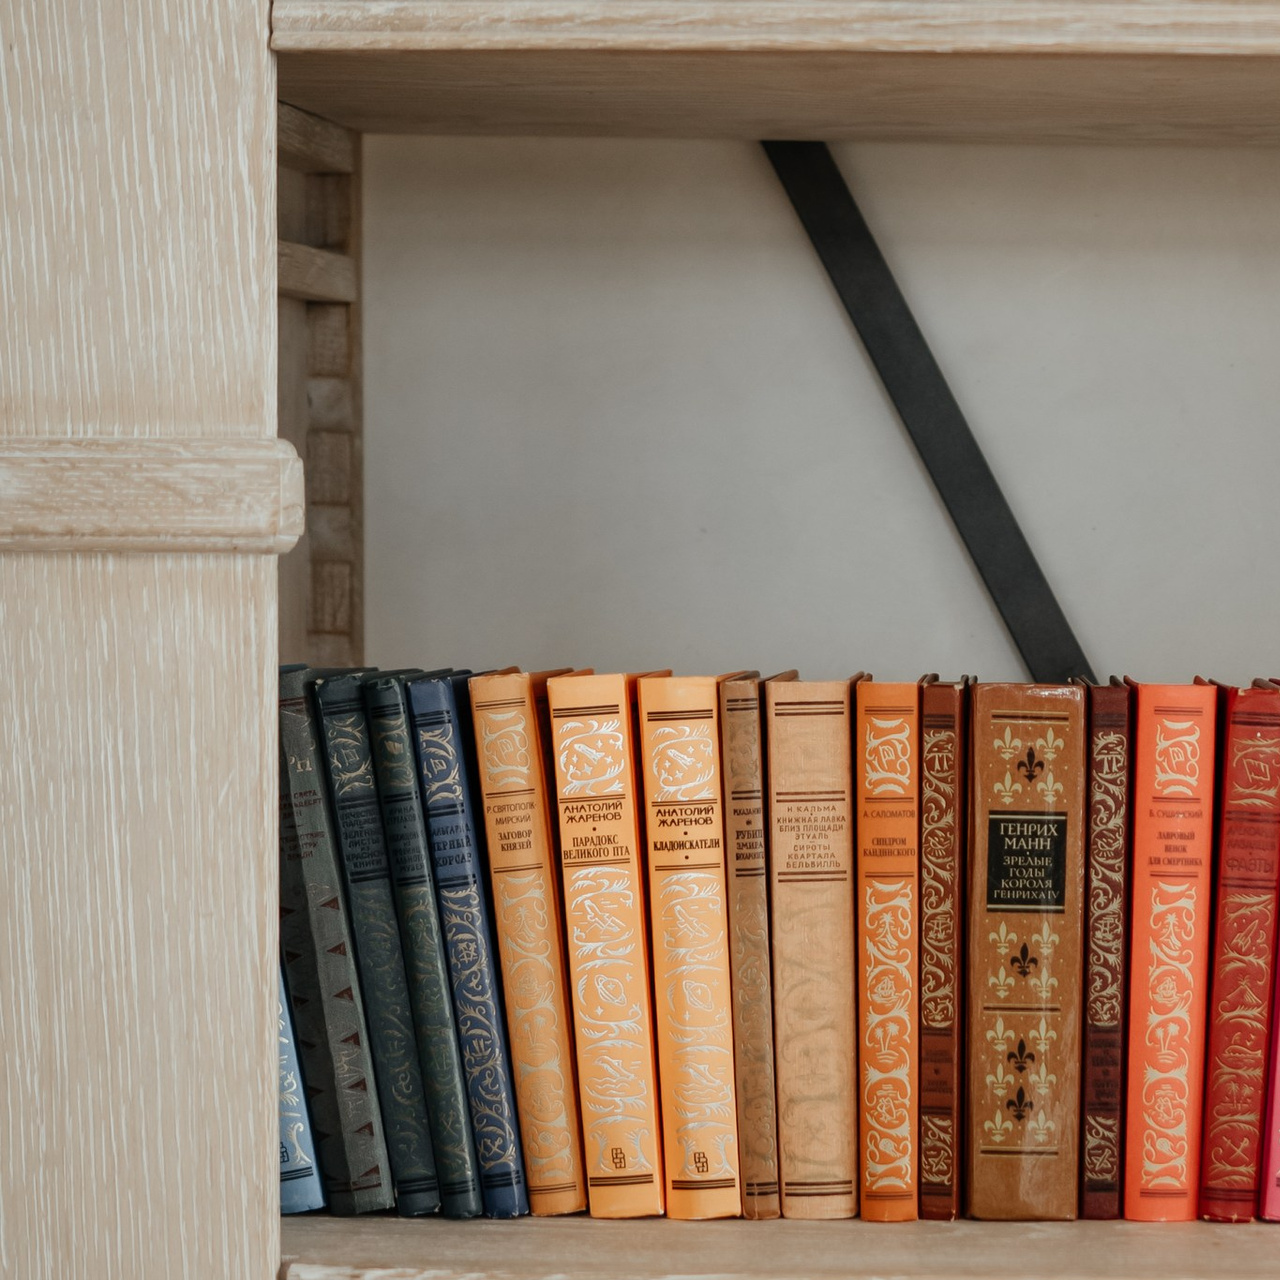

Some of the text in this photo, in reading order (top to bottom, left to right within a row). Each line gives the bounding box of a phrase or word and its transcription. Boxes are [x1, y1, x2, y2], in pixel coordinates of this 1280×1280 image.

[564, 801, 623, 814] АНАТОЛИЙ
[656, 805, 714, 818] АНАТОЛИЙ
[566, 812, 622, 824] ЖАРЕНОВ
[872, 809, 915, 819] САЛОМАТОВ
[496, 814, 531, 826] МИРСКИЙ
[658, 816, 713, 828] ЖАРЕНОВ
[777, 816, 818, 824] КНИЖНАЯ
[803, 824, 844, 832] ПЛОЩАДИ
[1000, 823, 1058, 836] ГЕНРИХ
[498, 830, 532, 842] ЗАГОВОР
[736, 829, 762, 840] РУБИН
[1156, 831, 1195, 840] ЛАВРОВЫЙ
[501, 838, 532, 852] КНЯЗЕЙ
[572, 834, 619, 847] ПАРАДОКС
[654, 838, 720, 852] КЛАДОИСКАТЕЛИ
[736, 842, 763, 850] ЭМИРА
[872, 837, 907, 846] СИНДРОМ
[1004, 838, 1051, 850] МАНН
[563, 845, 630, 860] ВЕЛИКОГО ПТА
[863, 848, 916, 858] КАНДИНСКОГО
[1164, 844, 1188, 853] ВЕНОК
[788, 852, 836, 860] КВАРТАЛА
[1003, 855, 1052, 867] ЗРЕЛЫЕ
[1148, 856, 1202, 866] ДЛЯ СМЕРТНИКА
[1226, 857, 1274, 873] ФАЭТЫ
[1010, 867, 1045, 878] ГОДЫ
[1001, 879, 1052, 889] КОРОЛЯ
[994, 890, 1060, 900] ГЕНРИХА IV
